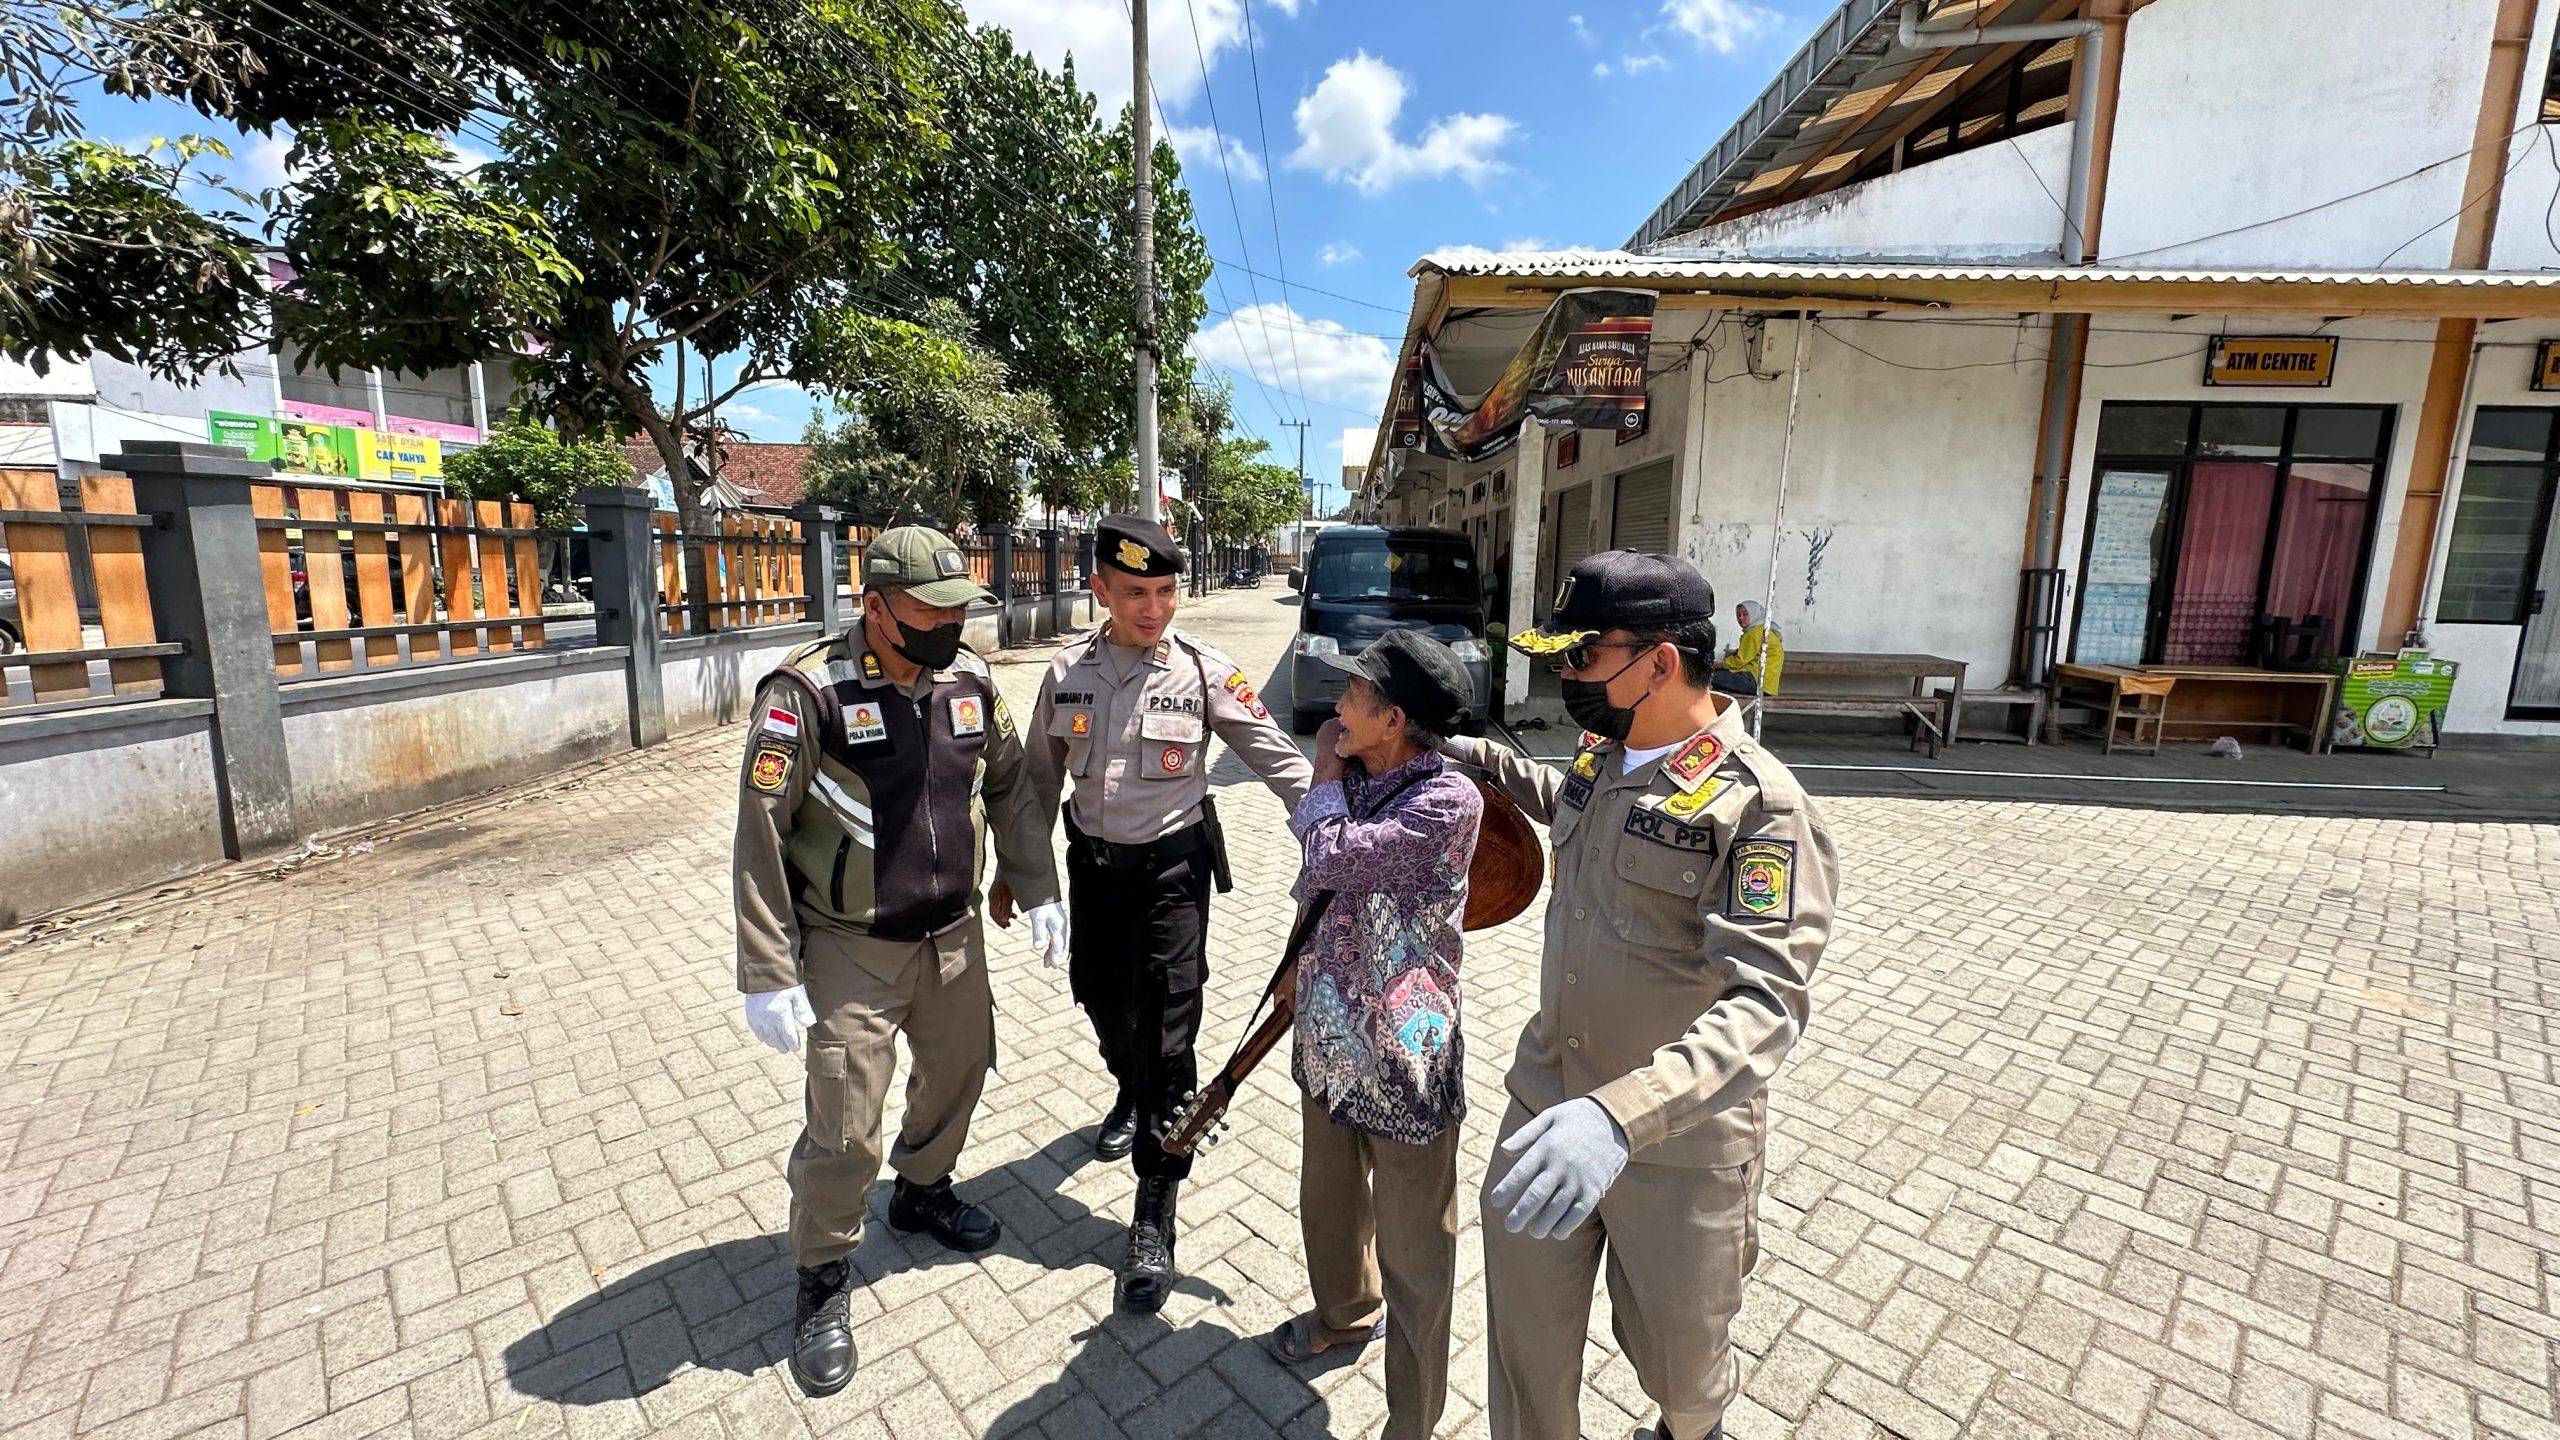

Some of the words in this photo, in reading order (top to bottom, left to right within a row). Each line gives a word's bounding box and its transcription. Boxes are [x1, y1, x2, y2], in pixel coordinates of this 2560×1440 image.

[1587, 353, 1625, 368] Surya
[2226, 352, 2258, 370] ATM
[2261, 352, 2318, 371] CENTRE
[1566, 366, 1642, 387] NUSANTARA
[375, 434, 397, 445] SATE
[400, 438, 424, 448] AYAM
[376, 450, 395, 461] CAK
[398, 452, 426, 463] YAHYA
[1150, 696, 1198, 712] POLRI
[1630, 812, 1665, 840] POL
[1675, 827, 1707, 847] PP
